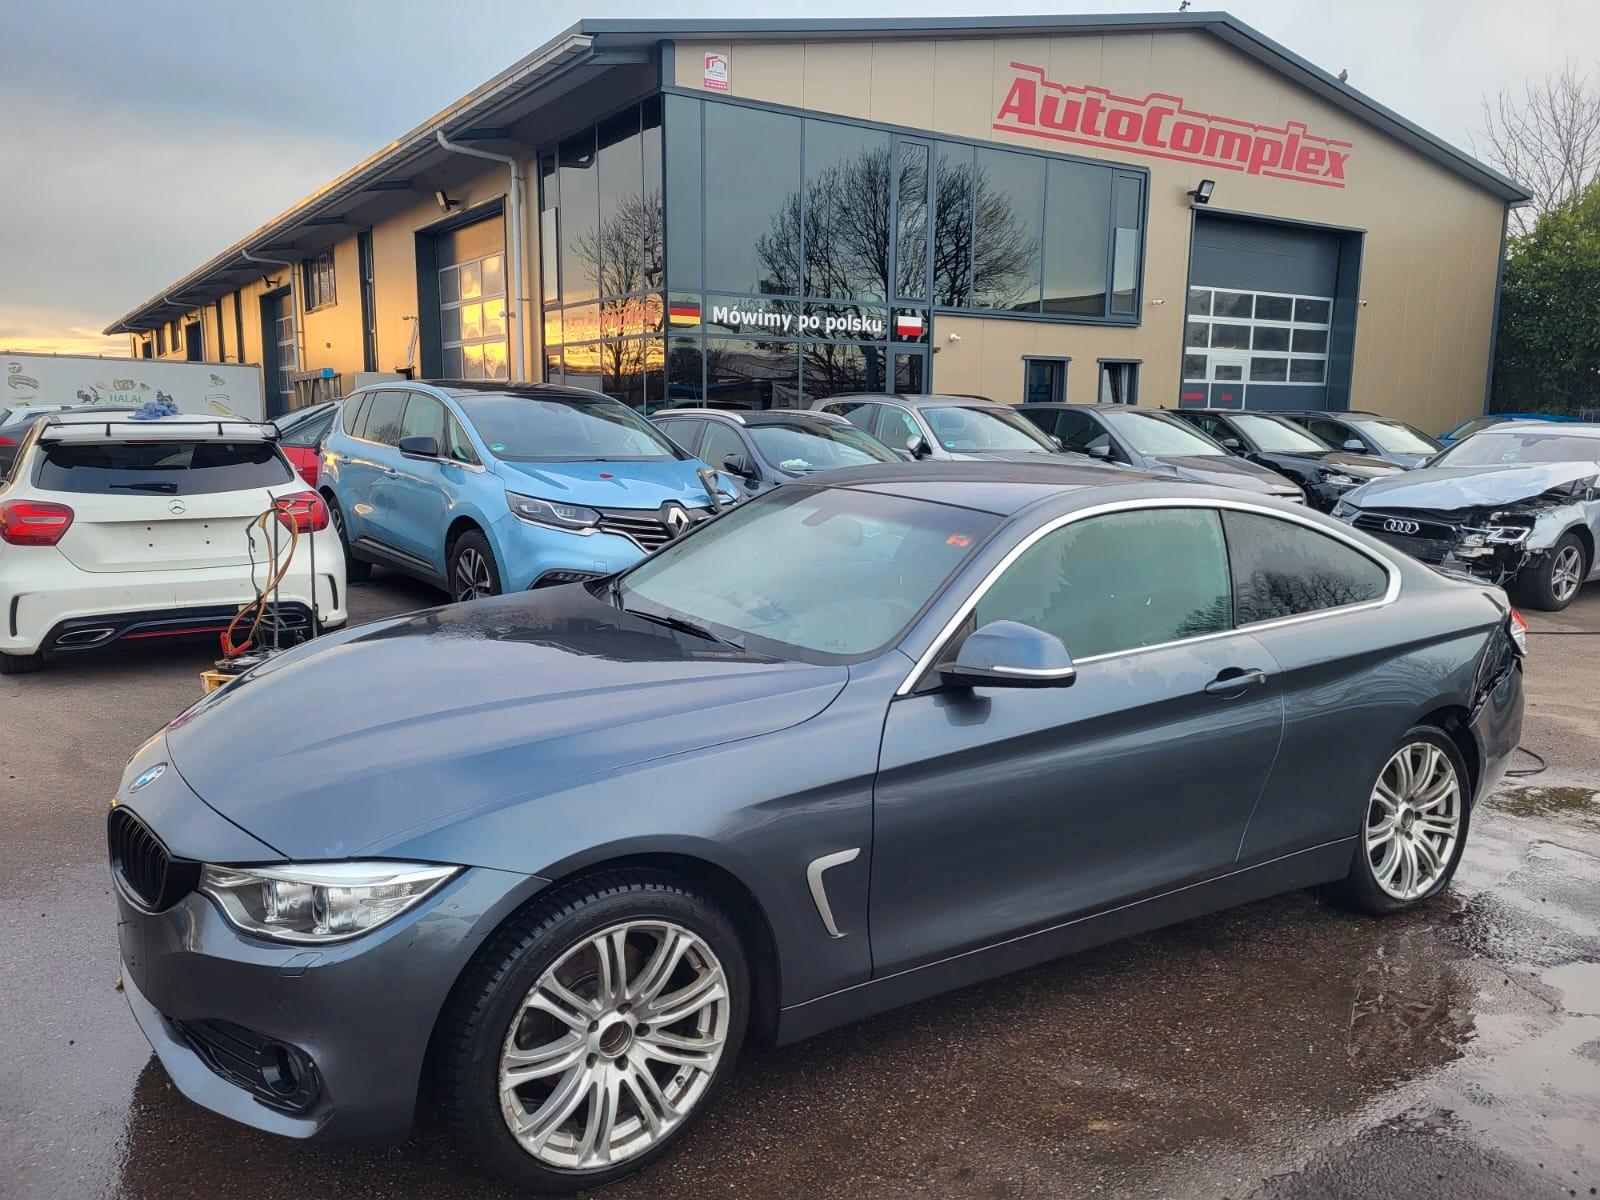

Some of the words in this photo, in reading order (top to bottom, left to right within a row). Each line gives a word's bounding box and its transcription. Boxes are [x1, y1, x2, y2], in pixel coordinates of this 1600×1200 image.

[997, 77, 1350, 179] AutoComplex
[712, 305, 792, 332] Mówimy
[798, 314, 822, 331] po
[825, 314, 882, 333] polsku
[109, 393, 144, 403] HALAL
